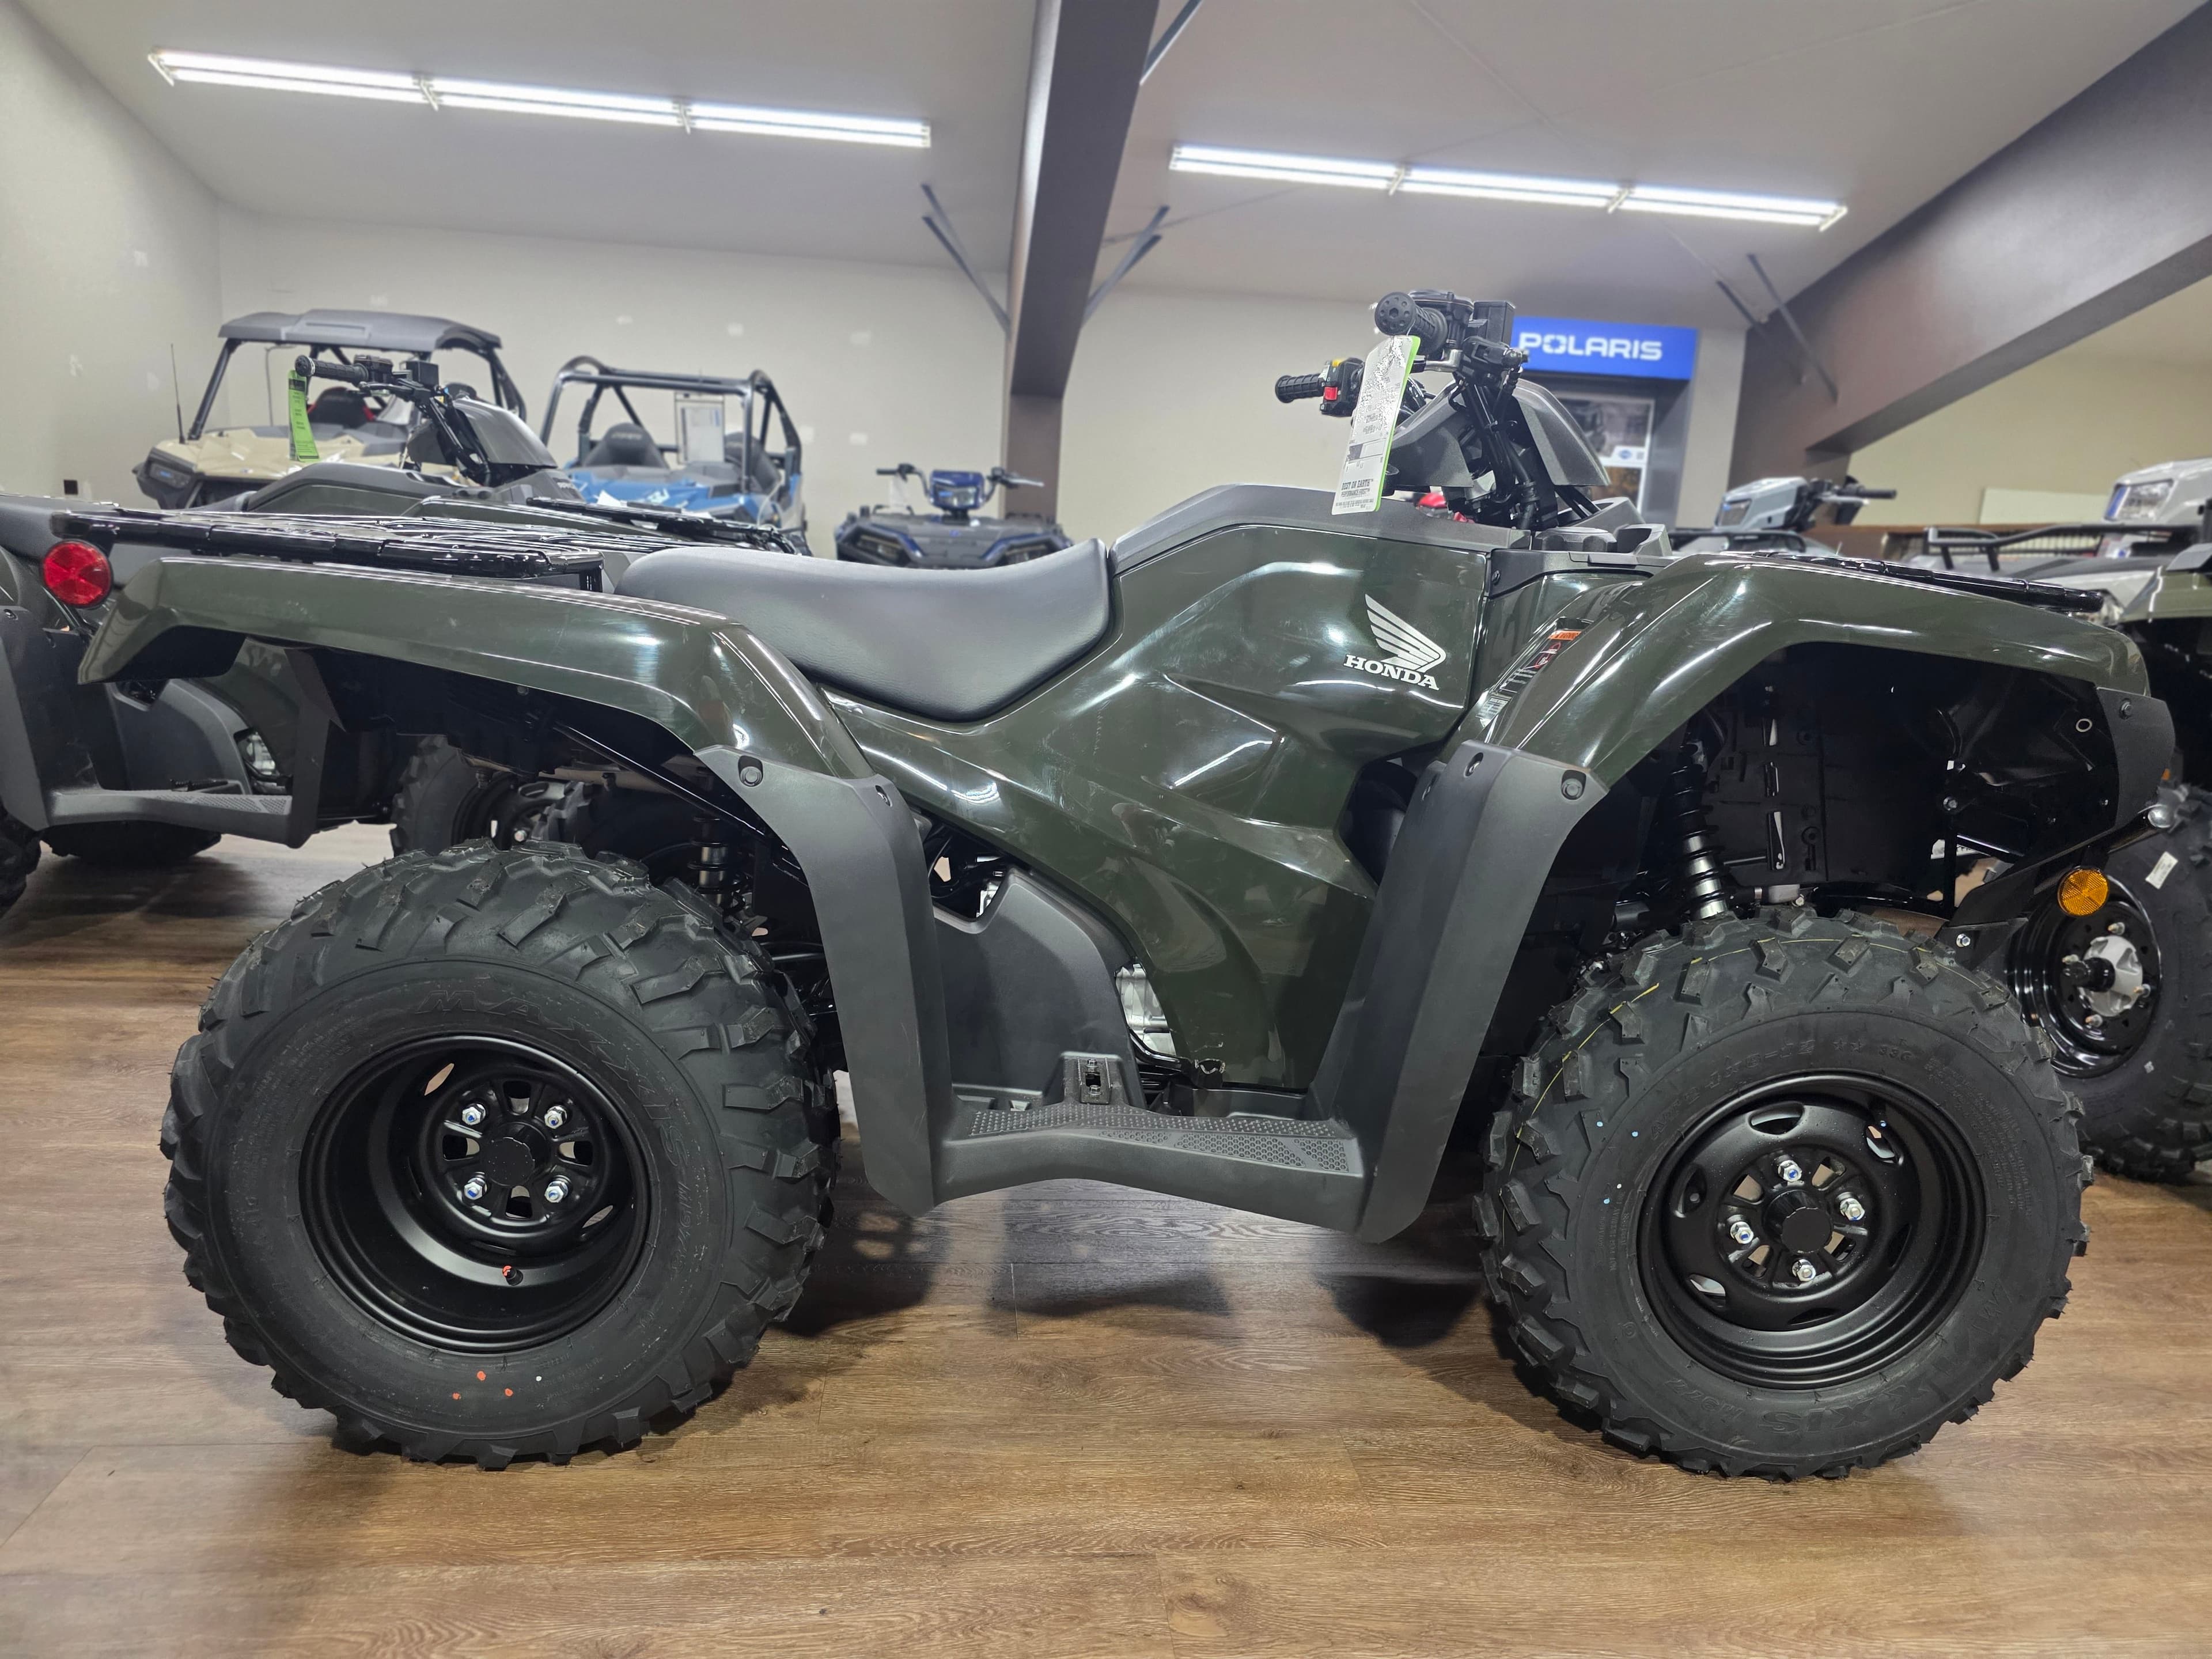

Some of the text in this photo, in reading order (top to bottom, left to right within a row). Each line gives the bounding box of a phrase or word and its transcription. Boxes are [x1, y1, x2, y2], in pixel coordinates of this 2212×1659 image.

[1518, 332, 1662, 360] POLARIS
[1343, 654, 1440, 691] HONDA
[414, 988, 689, 1168] MAXXIS
